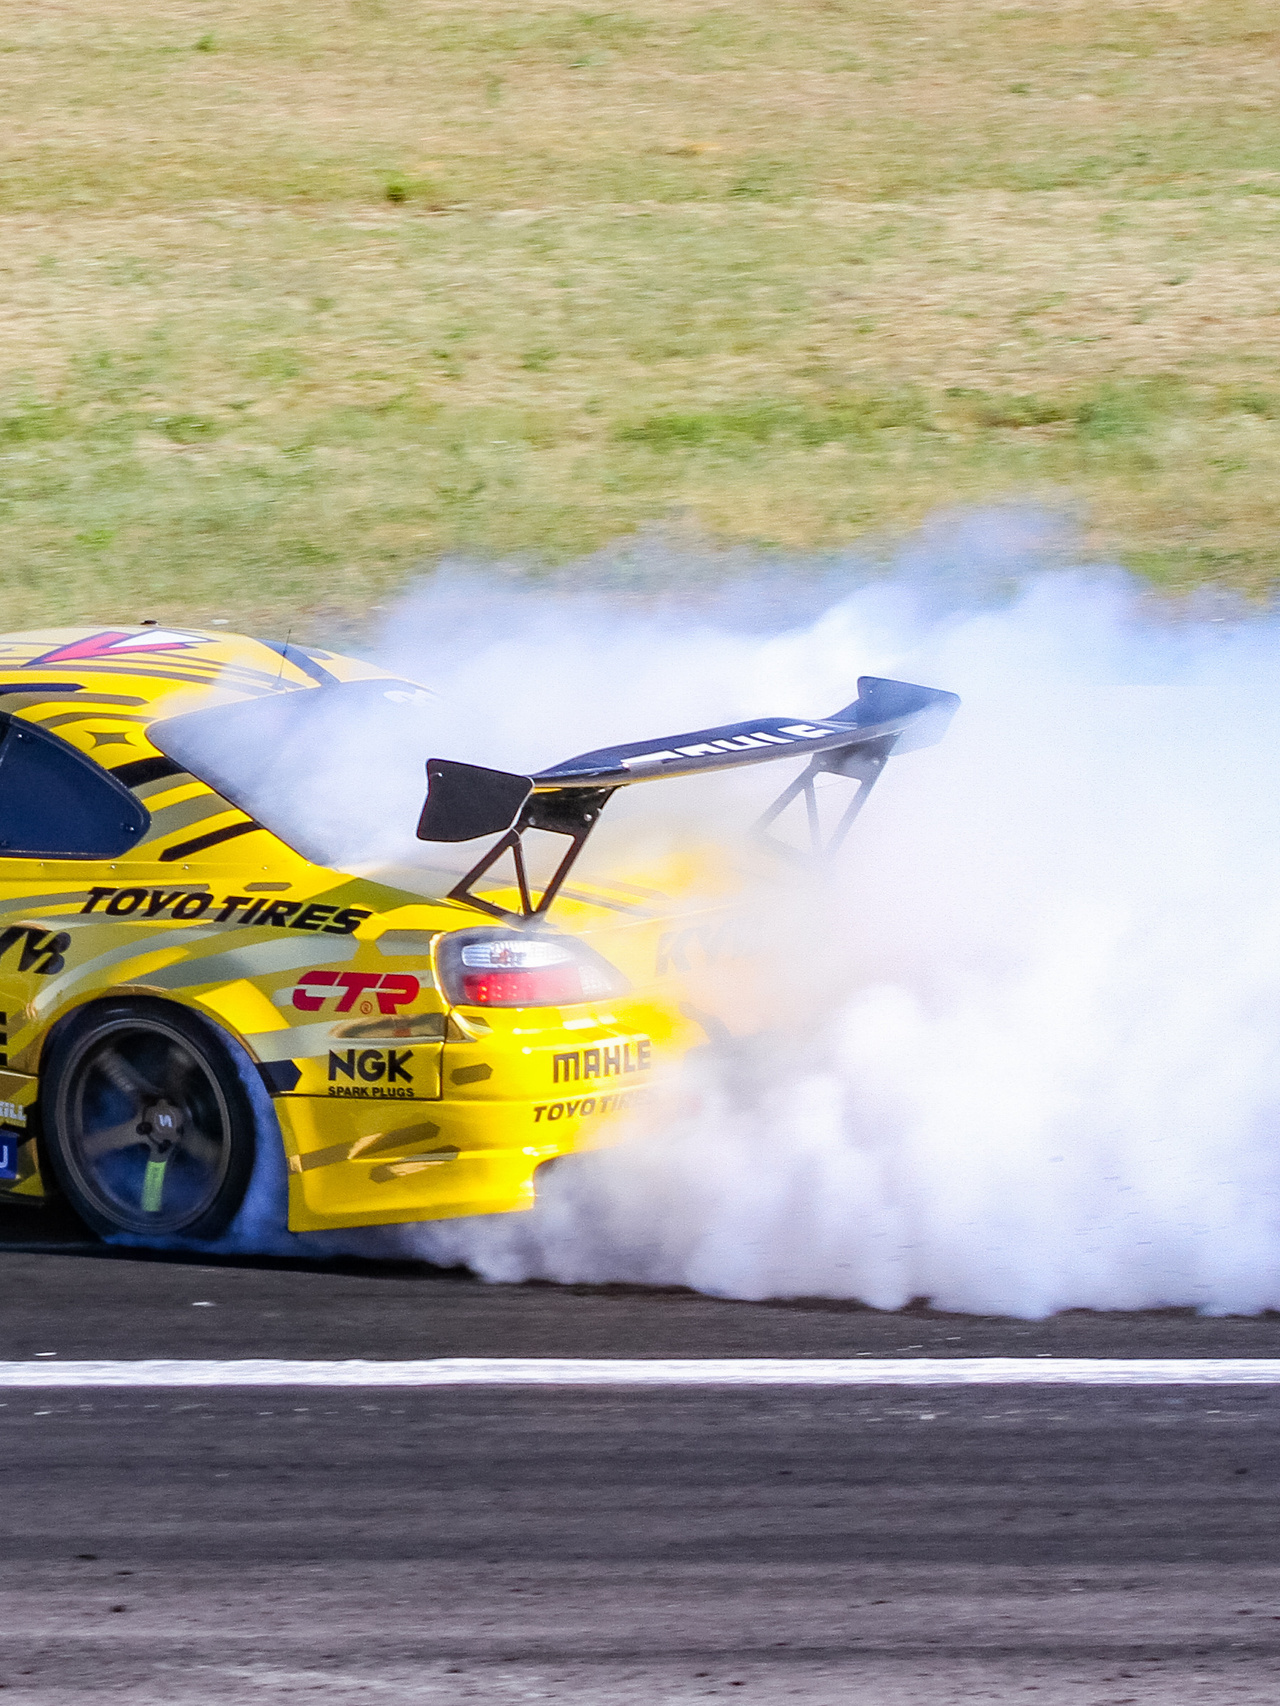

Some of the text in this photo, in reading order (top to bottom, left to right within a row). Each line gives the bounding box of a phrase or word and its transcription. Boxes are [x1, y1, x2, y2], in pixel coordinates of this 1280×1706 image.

[80, 887, 373, 935] TOYO TIRES
[328, 1048, 415, 1083] NGK
[553, 1039, 652, 1083] MAHLE
[328, 1086, 415, 1098] SPARK PLUGS
[533, 1097, 597, 1123] TOYO
